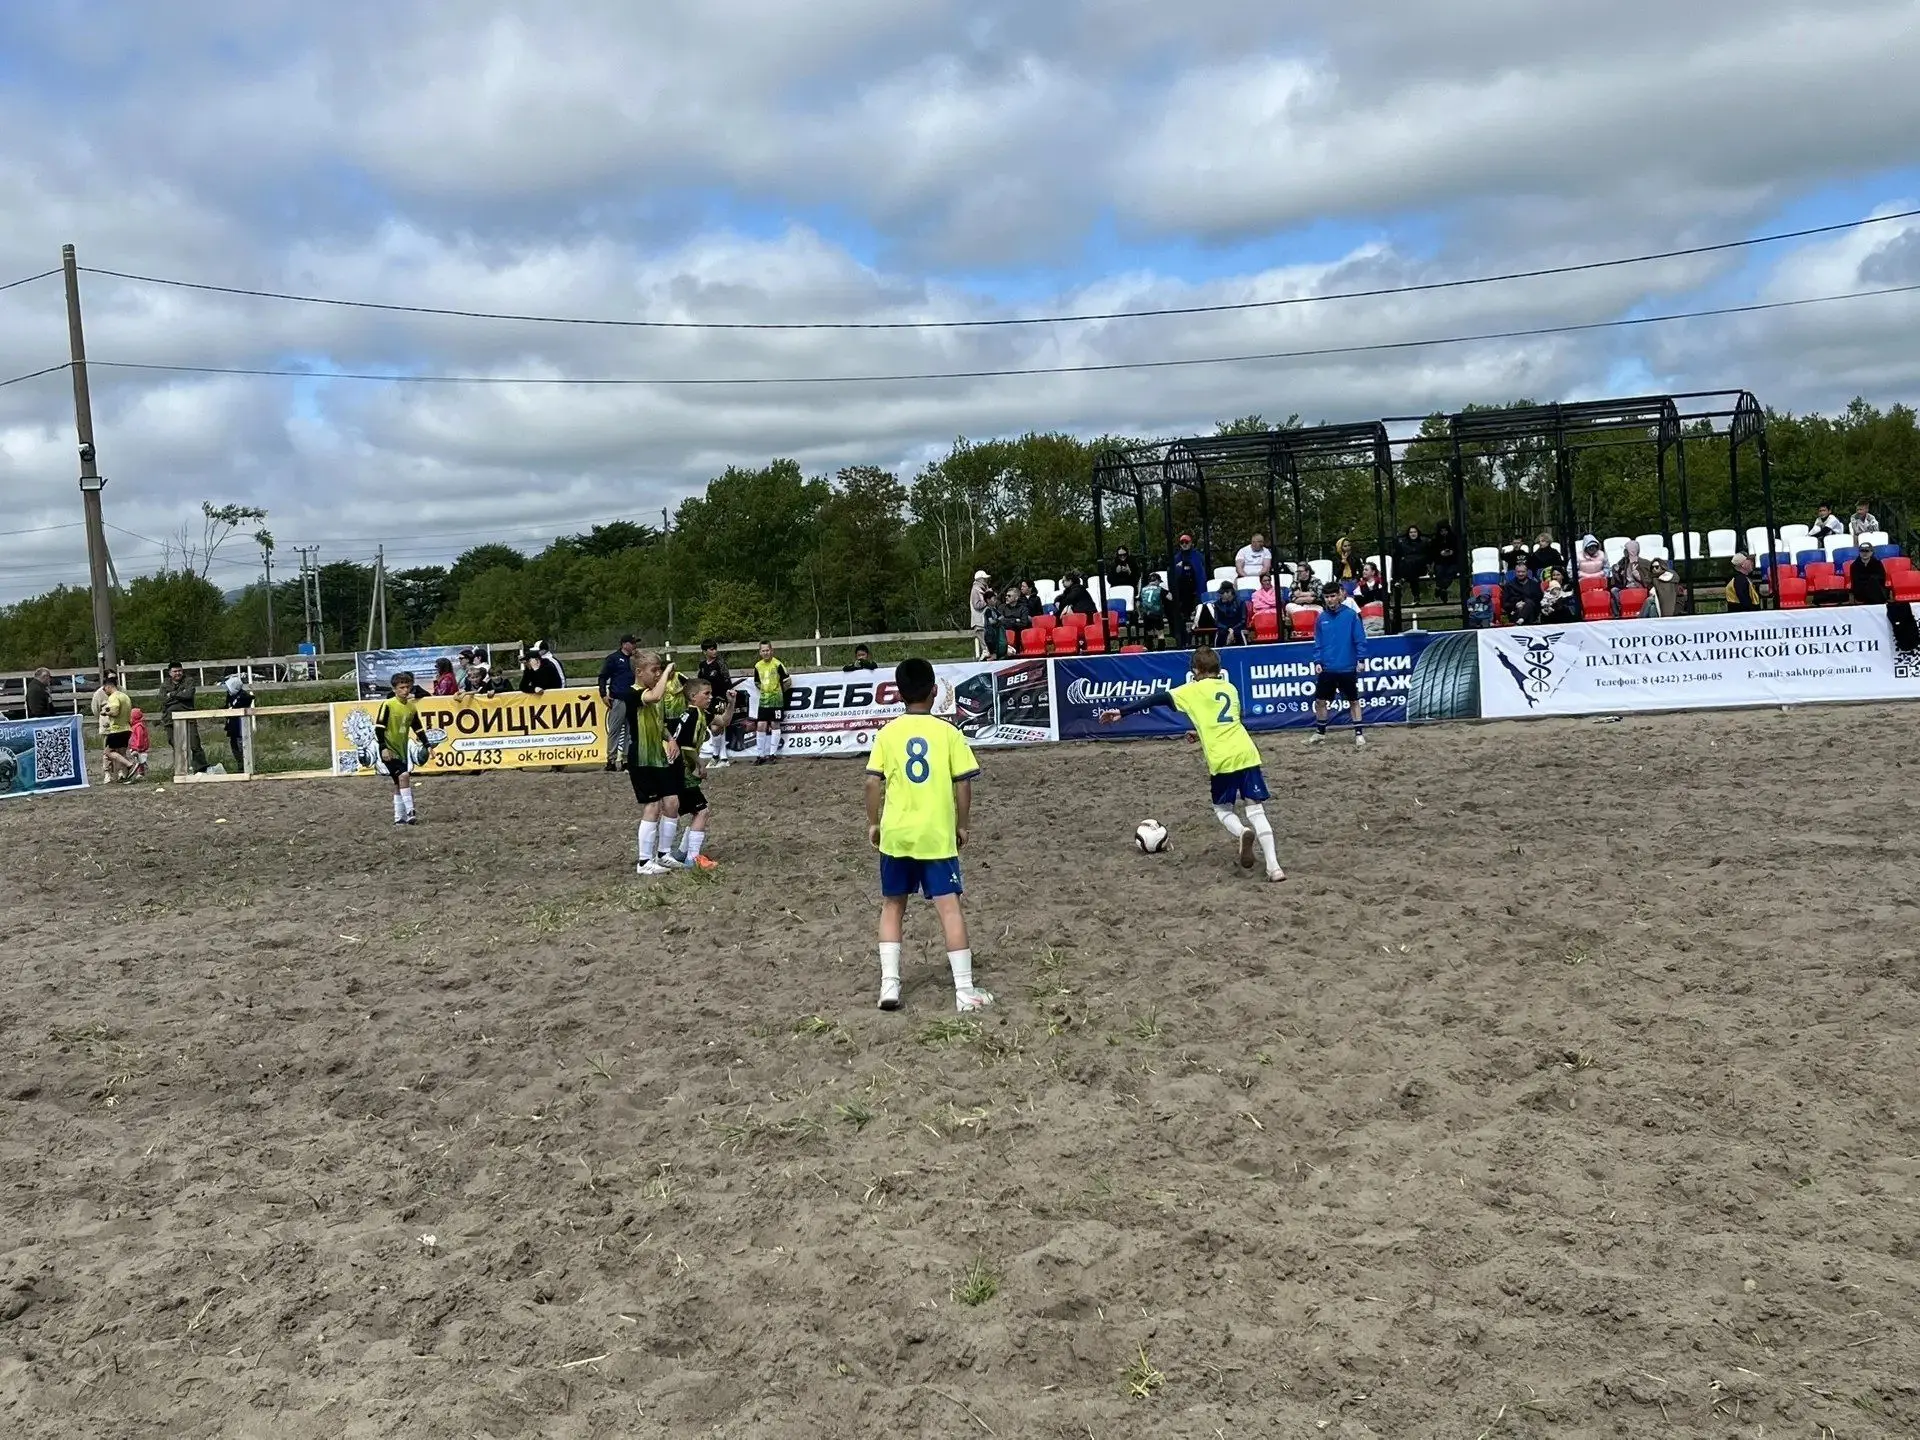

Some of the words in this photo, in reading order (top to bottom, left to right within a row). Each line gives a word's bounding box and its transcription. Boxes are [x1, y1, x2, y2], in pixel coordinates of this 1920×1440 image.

[1144, 590, 1154, 602] 7
[1608, 623, 1853, 650] ТОРГОВО-ПРОМЫШЛЕННАЯ
[1585, 652, 1651, 667] ПАЛАТА
[1656, 642, 1791, 664] САХАЛИНСКОЙ
[1794, 639, 1880, 657] ОБЛАСТИ
[1250, 663, 1316, 680] ШИНЫ
[1642, 676, 1649, 685] 8
[1650, 674, 1680, 685] (4242)
[1682, 672, 1723, 683] 23-00-05
[1747, 668, 1783, 679] E-mail:
[783, 681, 902, 711] ВЕБ6
[1085, 678, 1172, 698] ШИНЫЧ
[1252, 674, 1412, 699] ШИНОНТАЖ
[421, 695, 598, 735] ТРОИЦКИЙ
[1215, 692, 1234, 723] 2
[788, 735, 842, 748] 288-994
[435, 750, 502, 768] 300-433
[518, 747, 599, 762] ok-troickiy.ru
[904, 736, 931, 784] 8
